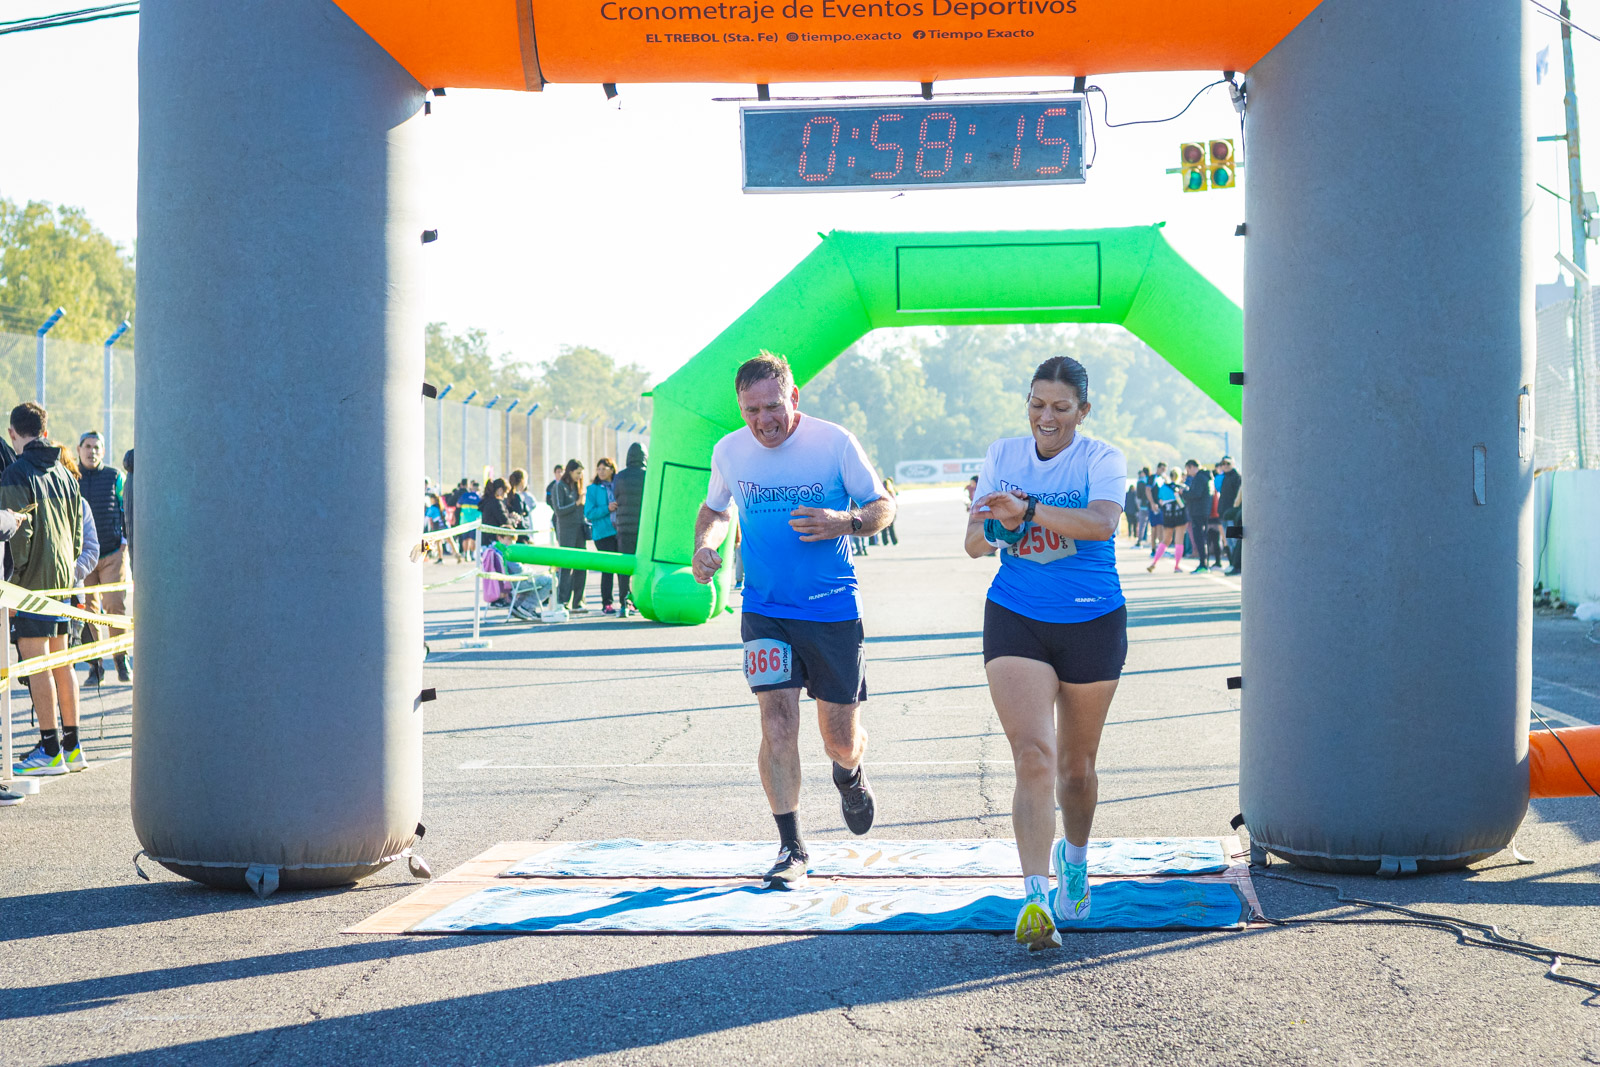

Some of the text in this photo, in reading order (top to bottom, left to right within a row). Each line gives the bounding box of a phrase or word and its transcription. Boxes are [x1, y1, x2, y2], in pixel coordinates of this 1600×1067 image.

[600, 0, 1077, 23] Cronometraje de Eventos Deportivos
[646, 32, 779, 44] EL TREBOL (Sta. Fe)
[801, 31, 902, 43] tiempo.exacto
[928, 28, 1035, 40] Tiempo Exacto
[1019, 525, 1060, 556] 250
[748, 647, 781, 675] 366
